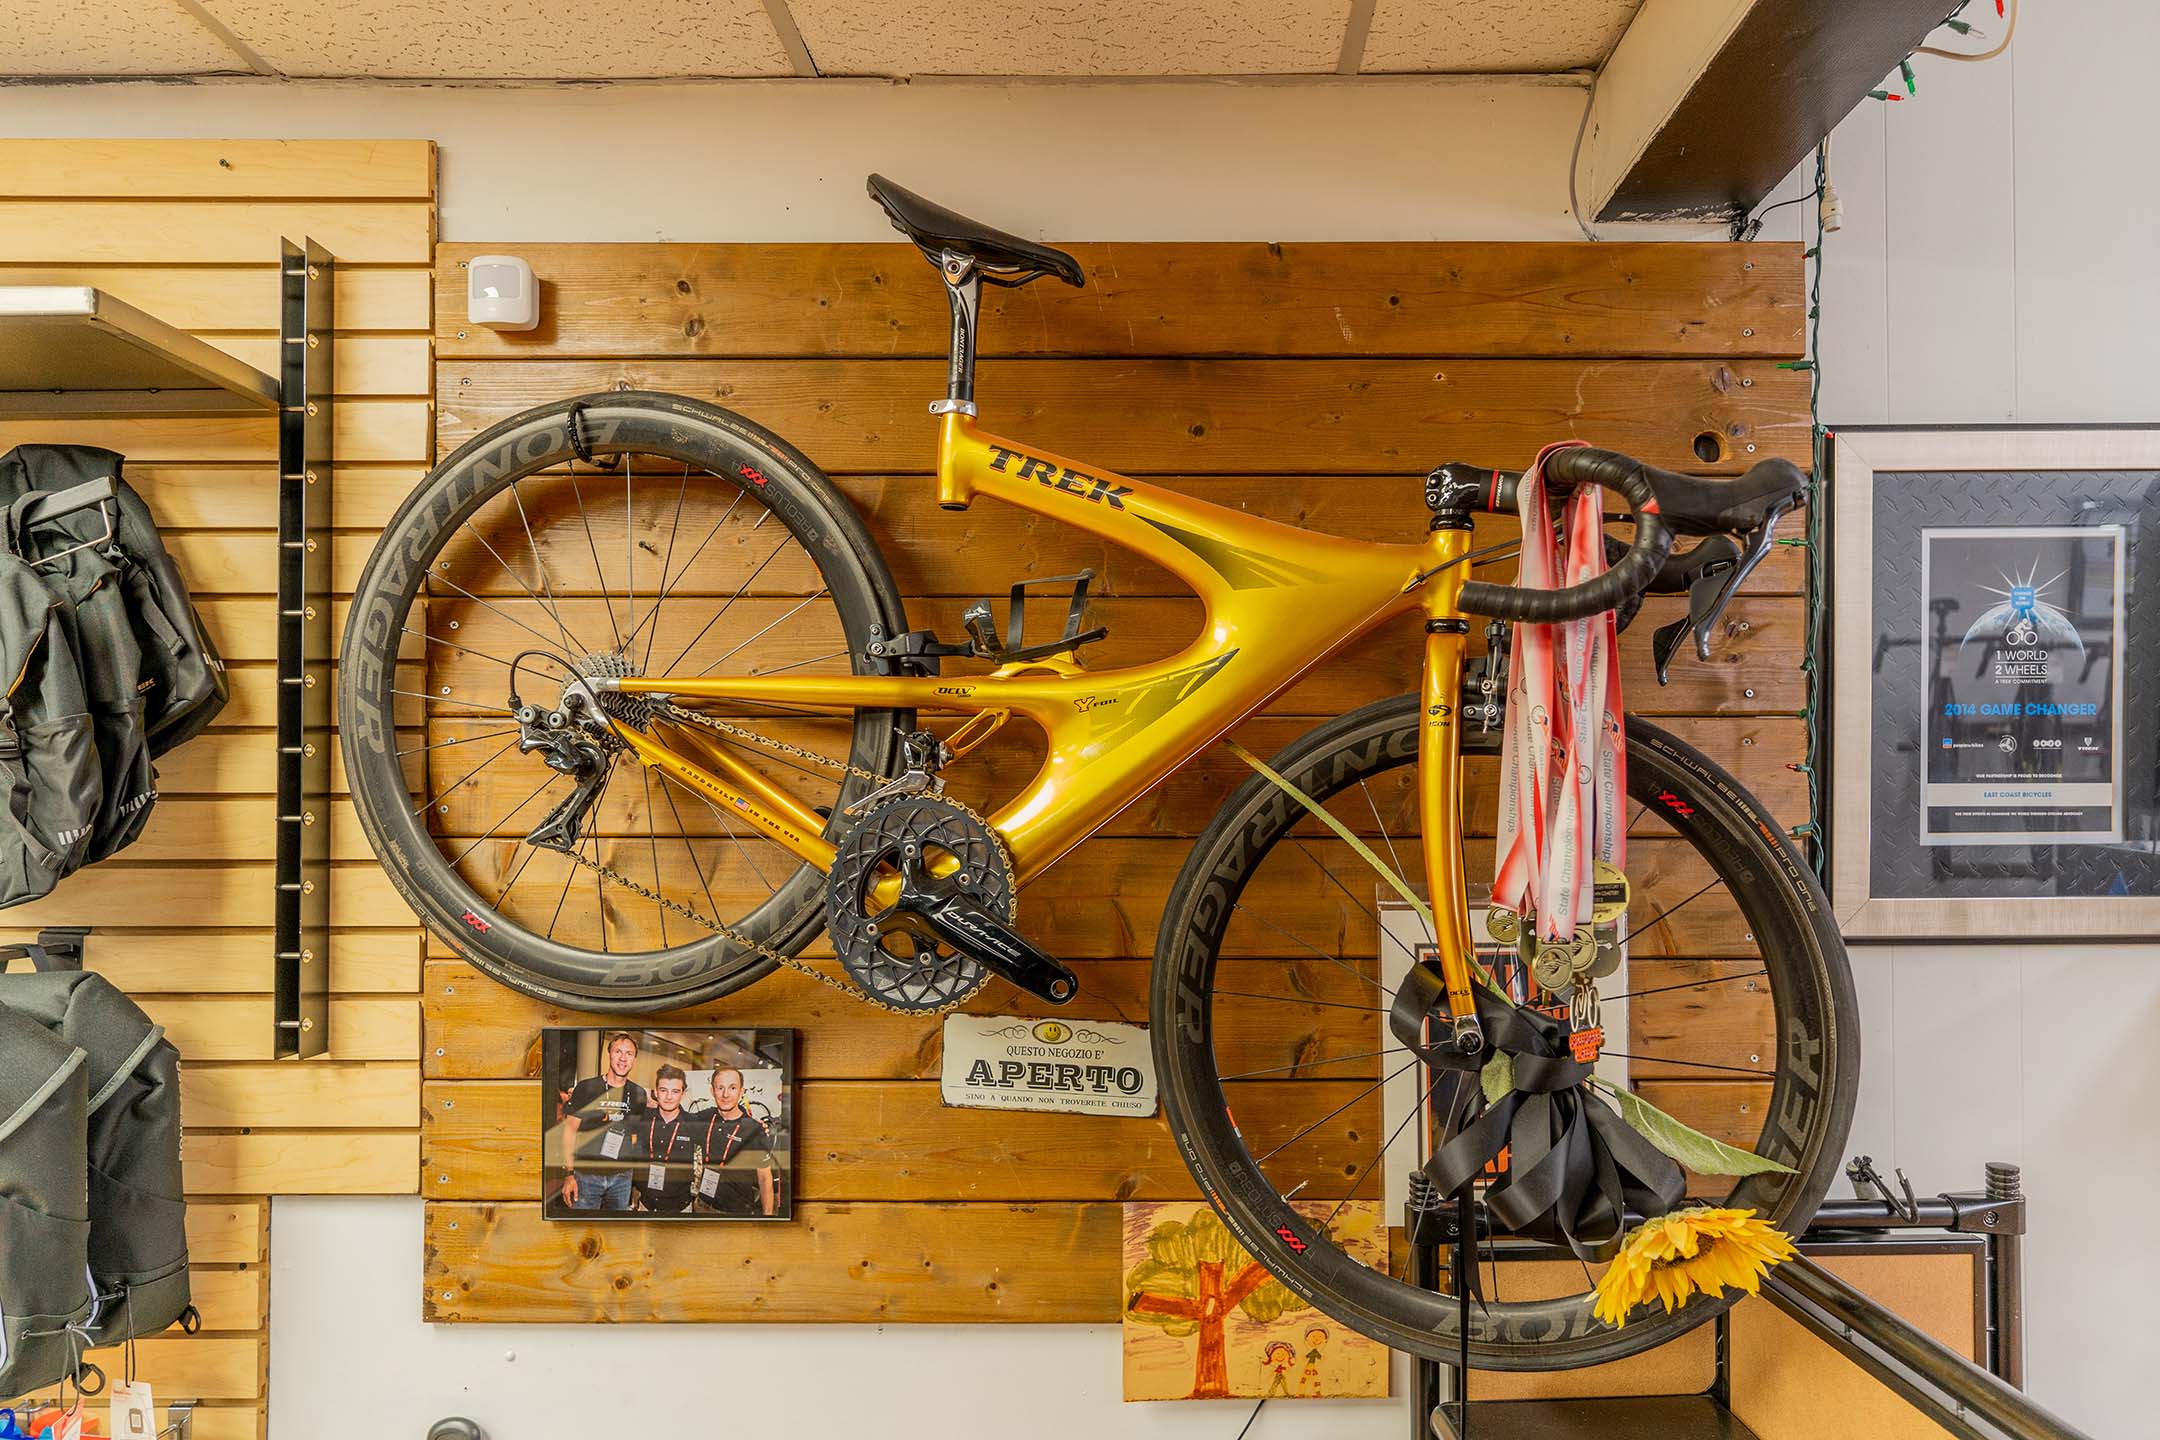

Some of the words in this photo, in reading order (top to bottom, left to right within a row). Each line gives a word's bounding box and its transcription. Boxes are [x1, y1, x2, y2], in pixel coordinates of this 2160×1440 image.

[958, 327, 966, 374] BONTRAGER
[672, 403, 748, 435] SCHWALBE
[788, 460, 810, 482] PRO
[989, 444, 1136, 512] TREK
[1995, 664, 2002, 675] 2
[2005, 664, 2048, 675] WHEELS
[1996, 651, 2001, 661] 1
[2005, 650, 2048, 661] WORLD
[1944, 703, 1977, 716] 2014
[1980, 703, 2022, 716] GAME
[2025, 703, 2097, 716] CHANGER
[1603, 750, 1614, 779] State
[1650, 738, 1738, 801] SCHWALBE
[680, 766, 735, 802] HANDBUILT
[749, 808, 760, 818] IN
[762, 817, 781, 831] THE
[783, 830, 800, 843] USA
[1601, 781, 1615, 864] Championships
[1776, 847, 1799, 878] PRO
[1797, 879, 1817, 912] ONE
[1558, 887, 1571, 916] State
[946, 911, 1021, 957] DURA-ACE
[484, 961, 559, 999] SCHWALBE
[1006, 1045, 1046, 1057] QUESTO
[1048, 1047, 1092, 1059] NEGOZIO
[965, 1059, 1144, 1095] APERTO
[1001, 1095, 1033, 1103] QUANDO
[1060, 1098, 1108, 1107] TROVERETE
[1111, 1101, 1142, 1109] CHIUSO
[1181, 1133, 1197, 1160] ONE
[1195, 1161, 1213, 1191] PRO
[1244, 1234, 1313, 1298] SCHWALBE
